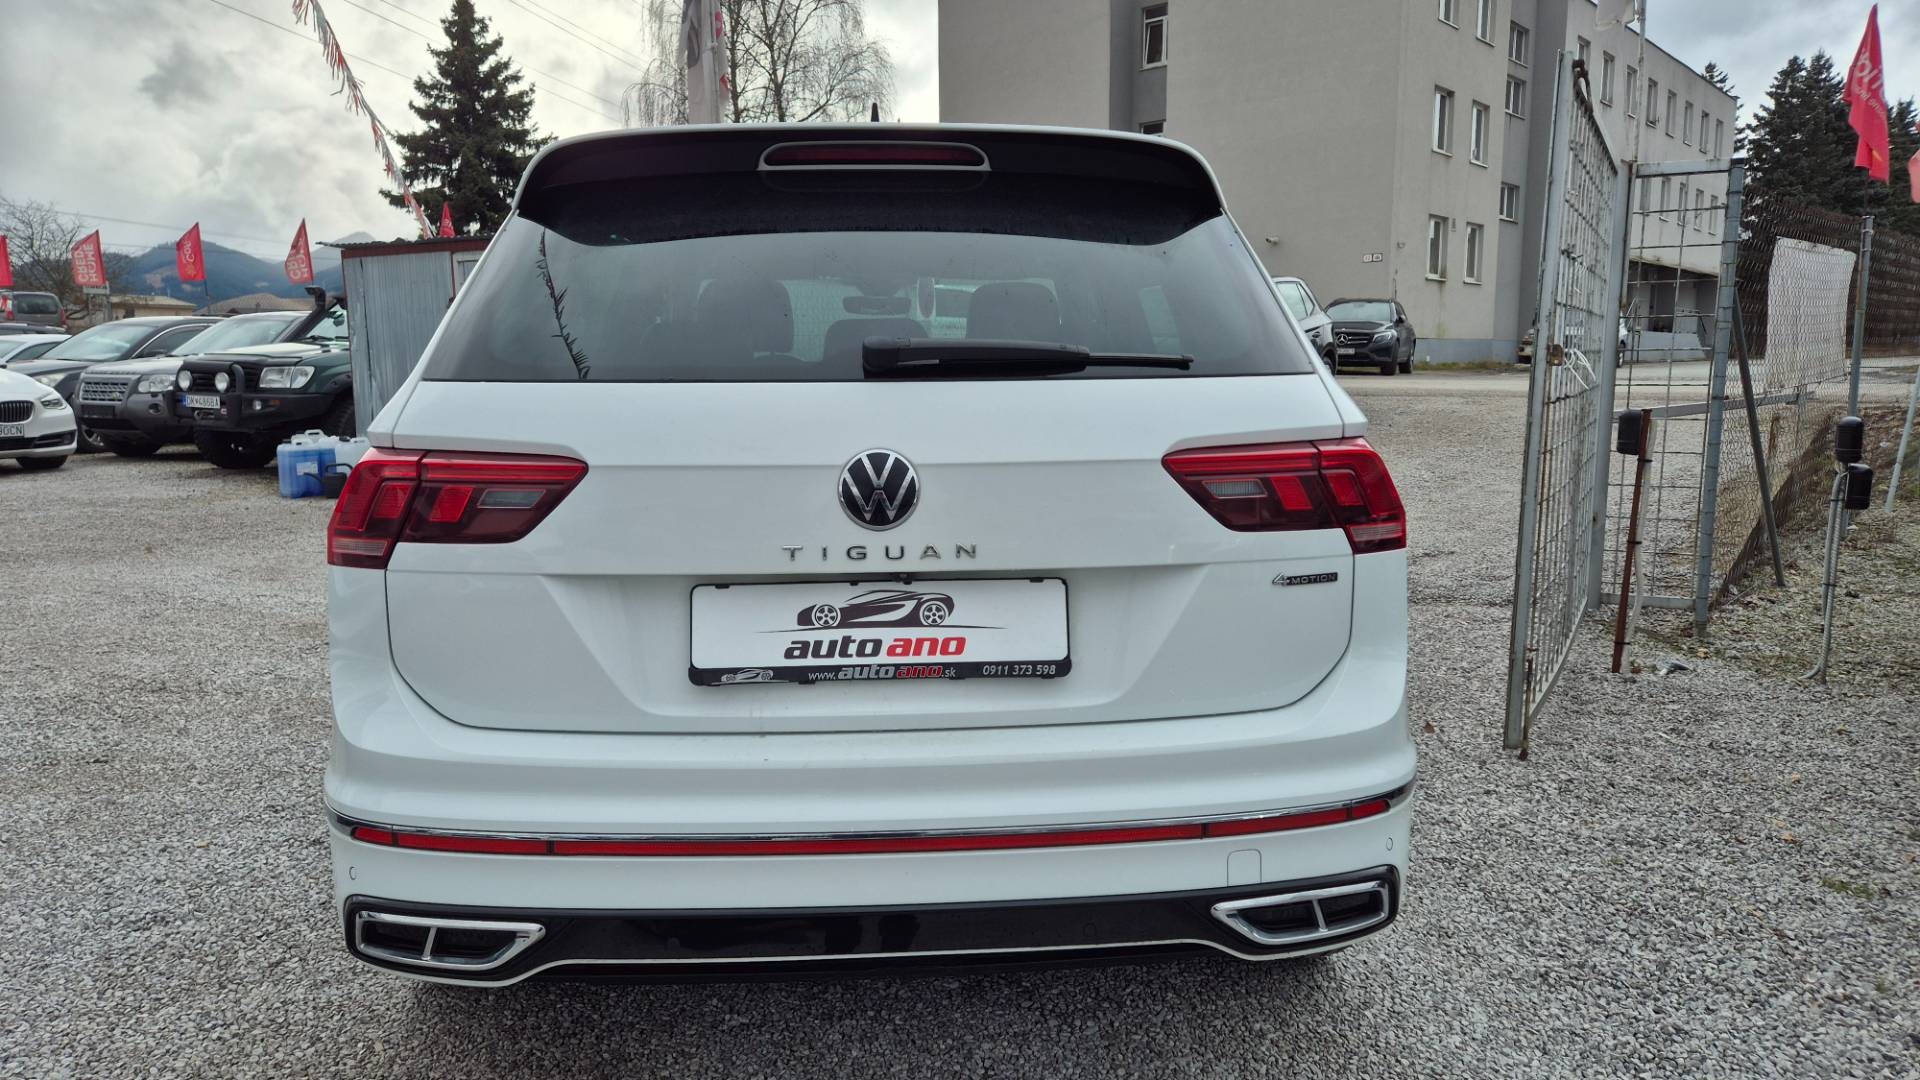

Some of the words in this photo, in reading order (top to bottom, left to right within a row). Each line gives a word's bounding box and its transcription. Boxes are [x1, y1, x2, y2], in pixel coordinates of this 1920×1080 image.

[782, 543, 977, 562] TIGUAN
[1272, 572, 1338, 586] 4MOTION
[783, 635, 883, 659] auto
[886, 636, 967, 658] ano
[982, 664, 1010, 676] 0911
[1012, 664, 1033, 675] 373
[1035, 664, 1057, 675] 598
